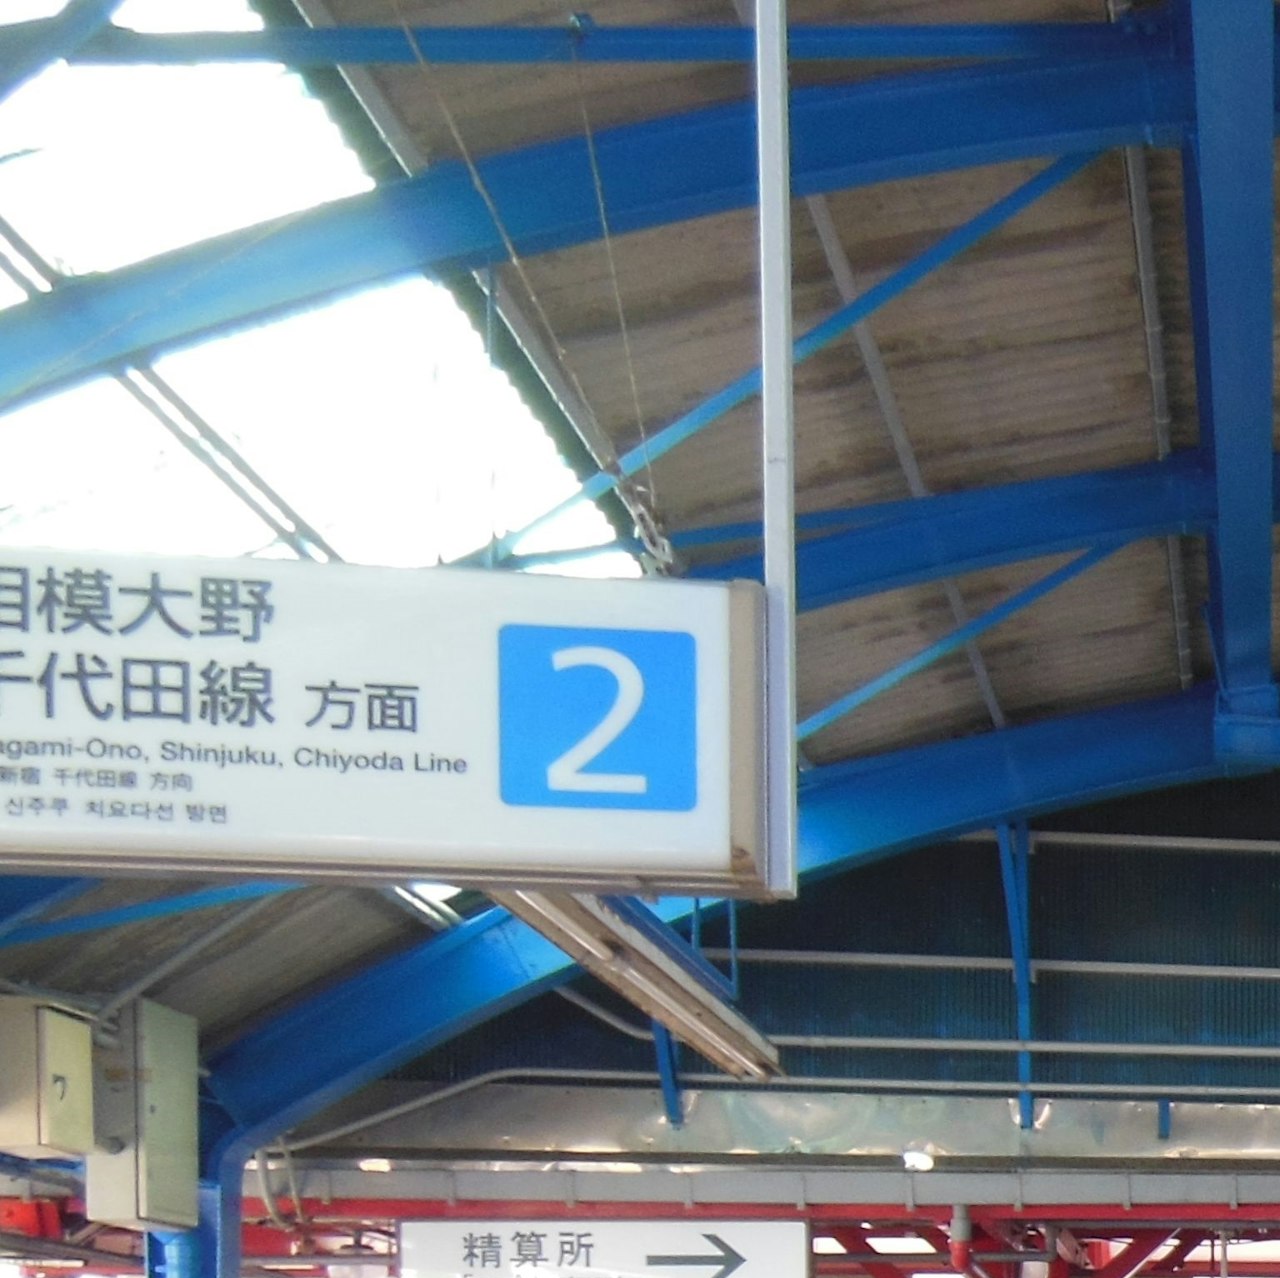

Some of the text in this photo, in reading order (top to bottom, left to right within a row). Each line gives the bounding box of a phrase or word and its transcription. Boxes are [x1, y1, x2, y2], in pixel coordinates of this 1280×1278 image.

[304, 682, 421, 733] 方面
[547, 646, 648, 793] 2
[0, 738, 467, 774] gami-Ono, Shinjuku, Chiyoda Line
[150, 772, 194, 792] 方向
[461, 1231, 595, 1269] 精算所
